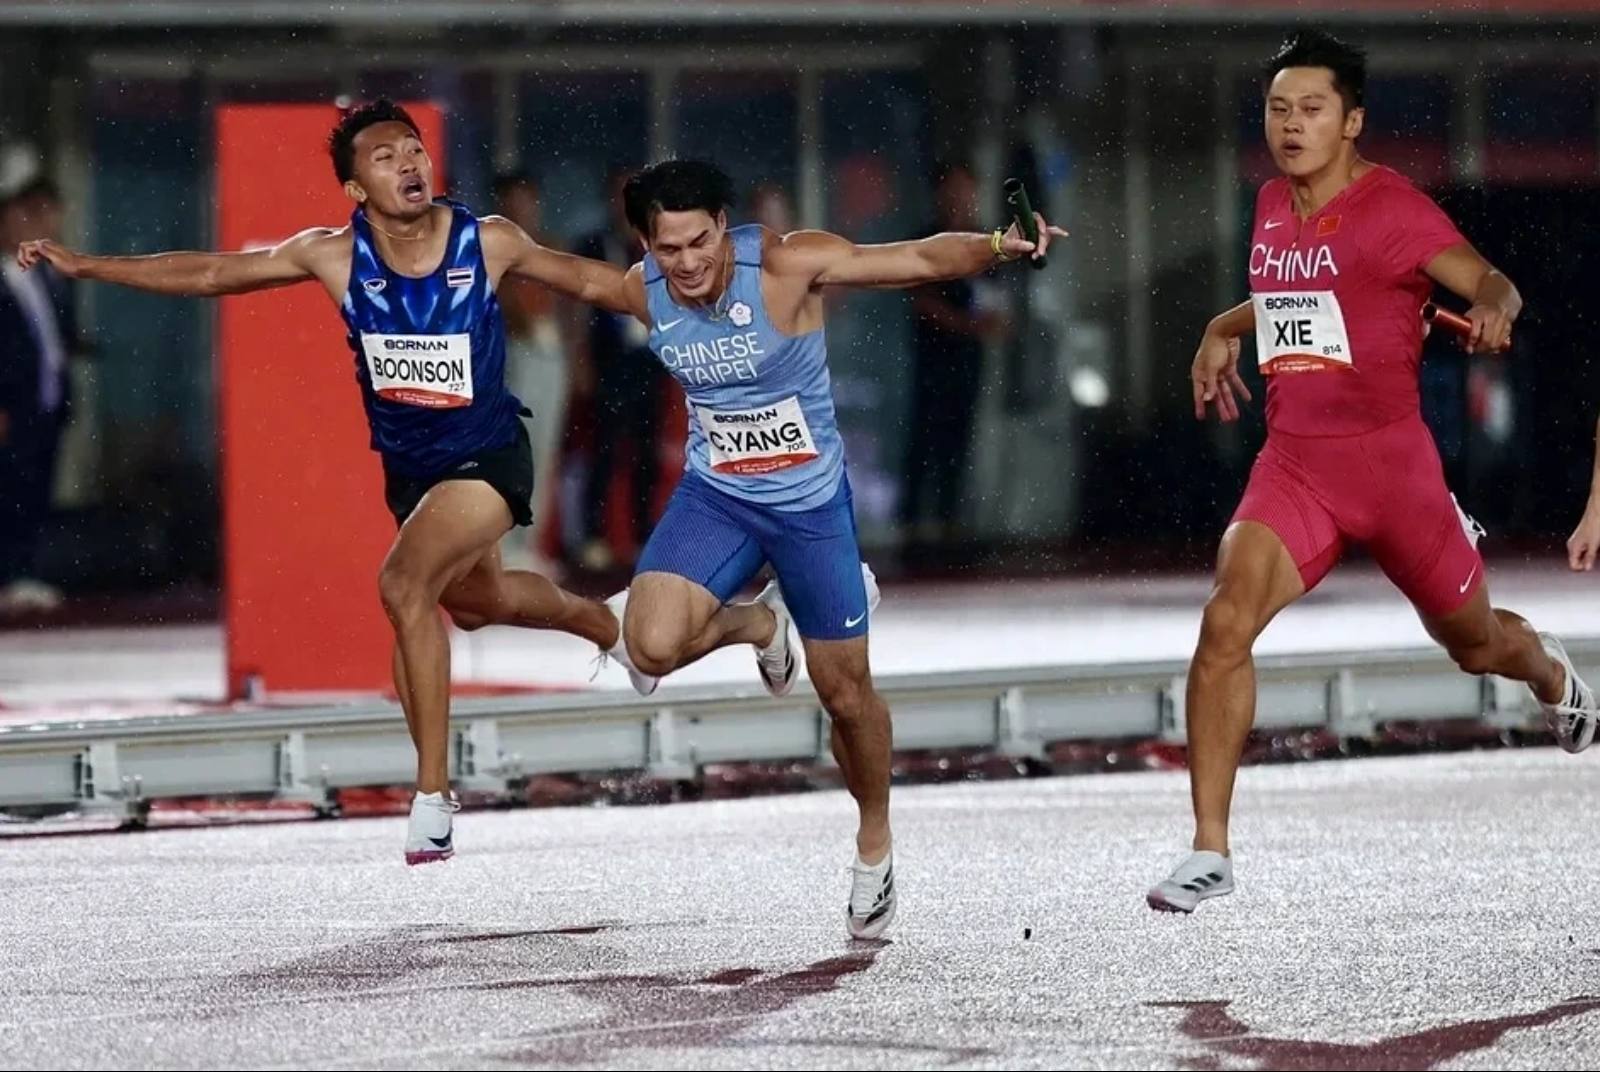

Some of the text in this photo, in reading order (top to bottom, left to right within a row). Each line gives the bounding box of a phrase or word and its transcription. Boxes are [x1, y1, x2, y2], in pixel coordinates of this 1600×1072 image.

[1249, 242, 1339, 282] CHINA
[1265, 297, 1318, 309] BORNAN
[384, 339, 448, 350] BORNAN
[1274, 319, 1313, 347] XIE
[661, 332, 764, 368] CHINESE
[1322, 344, 1342, 355] 814
[373, 356, 464, 383] BOONSON
[680, 359, 758, 385] TAIPEI
[449, 382, 465, 392] 727
[713, 408, 778, 424] BORNAN
[709, 422, 802, 453] C.YANG
